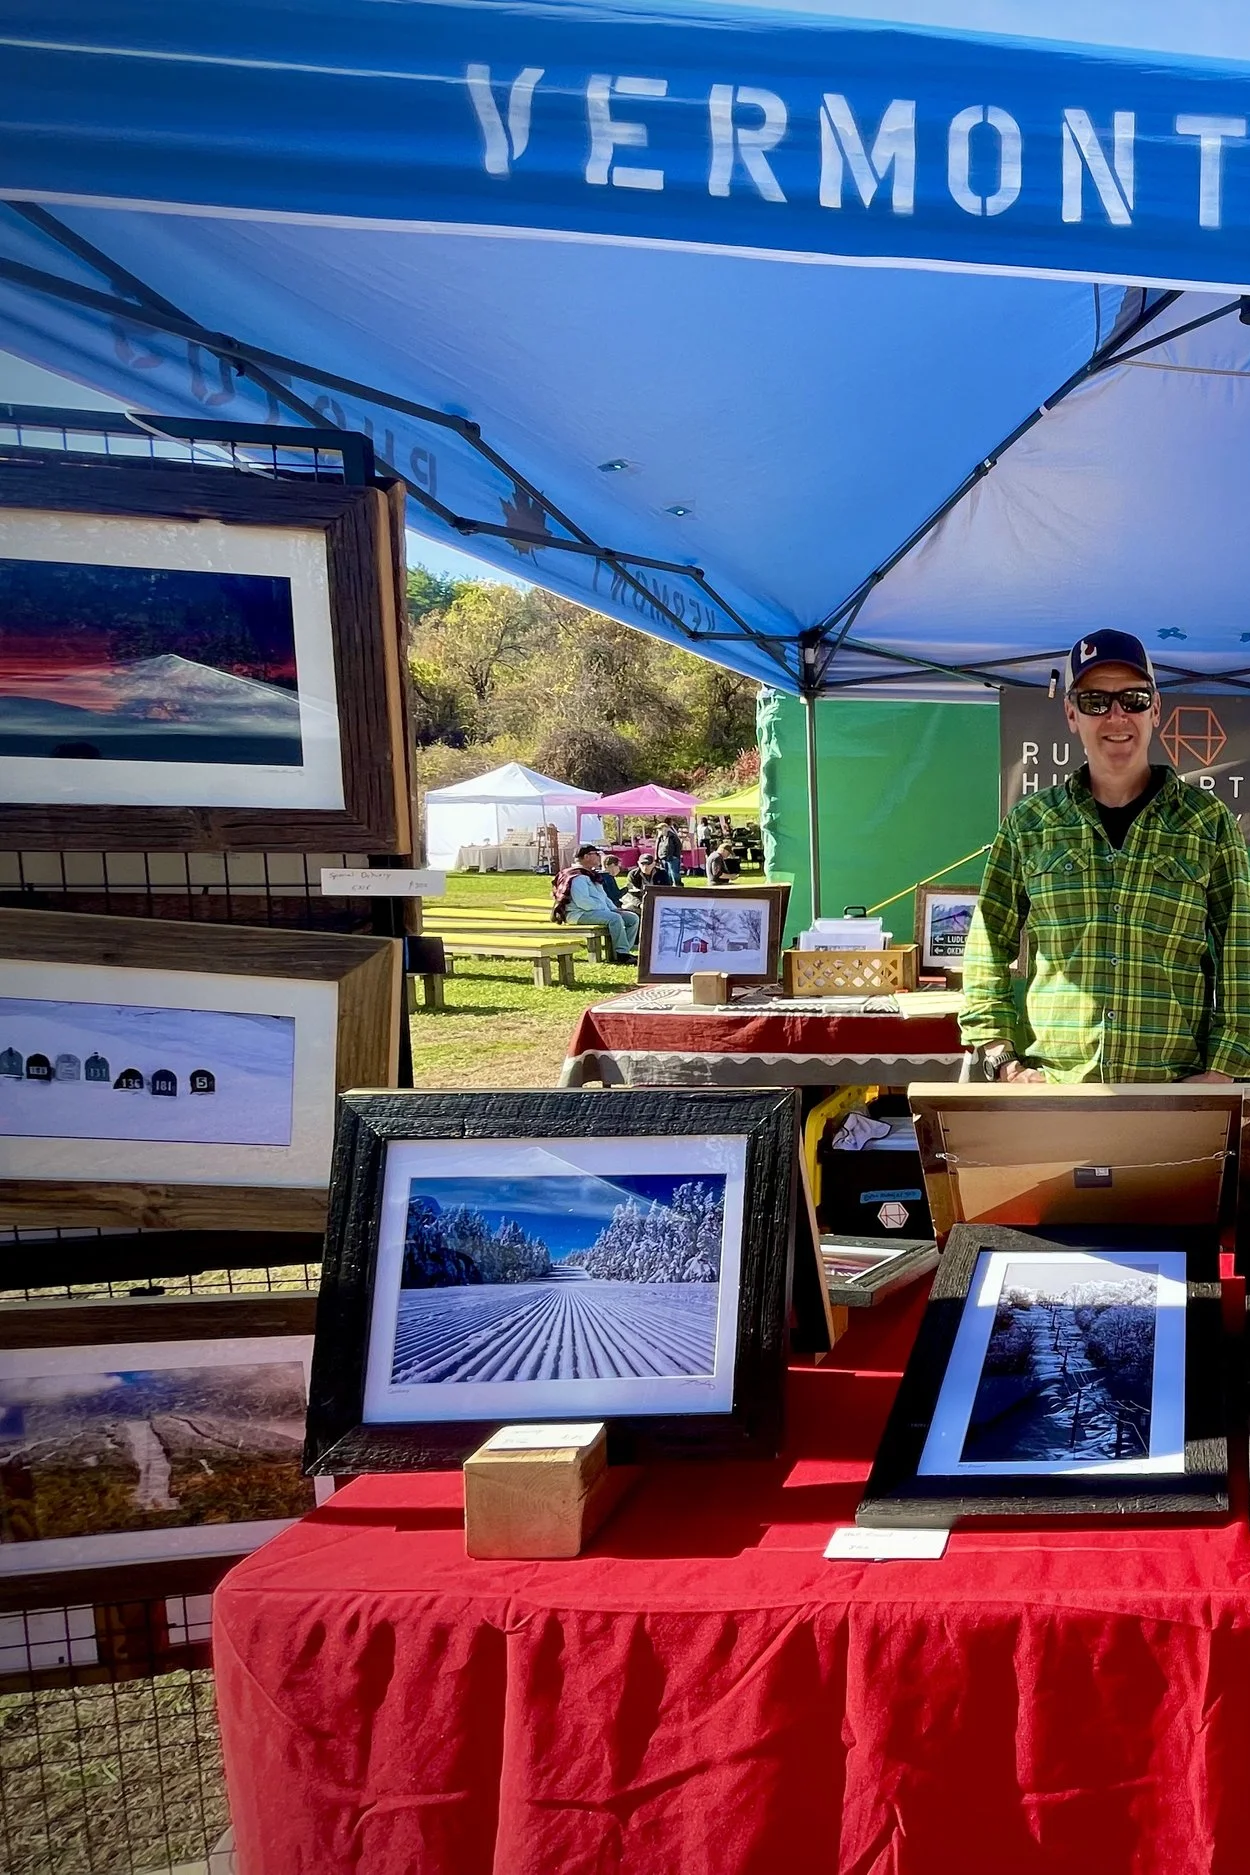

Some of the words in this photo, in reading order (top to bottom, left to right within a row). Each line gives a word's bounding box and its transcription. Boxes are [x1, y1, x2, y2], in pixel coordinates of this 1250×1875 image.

[465, 62, 1247, 230] VERMONT
[1022, 741, 1088, 766] RU
[155, 1080, 173, 1091] 181
